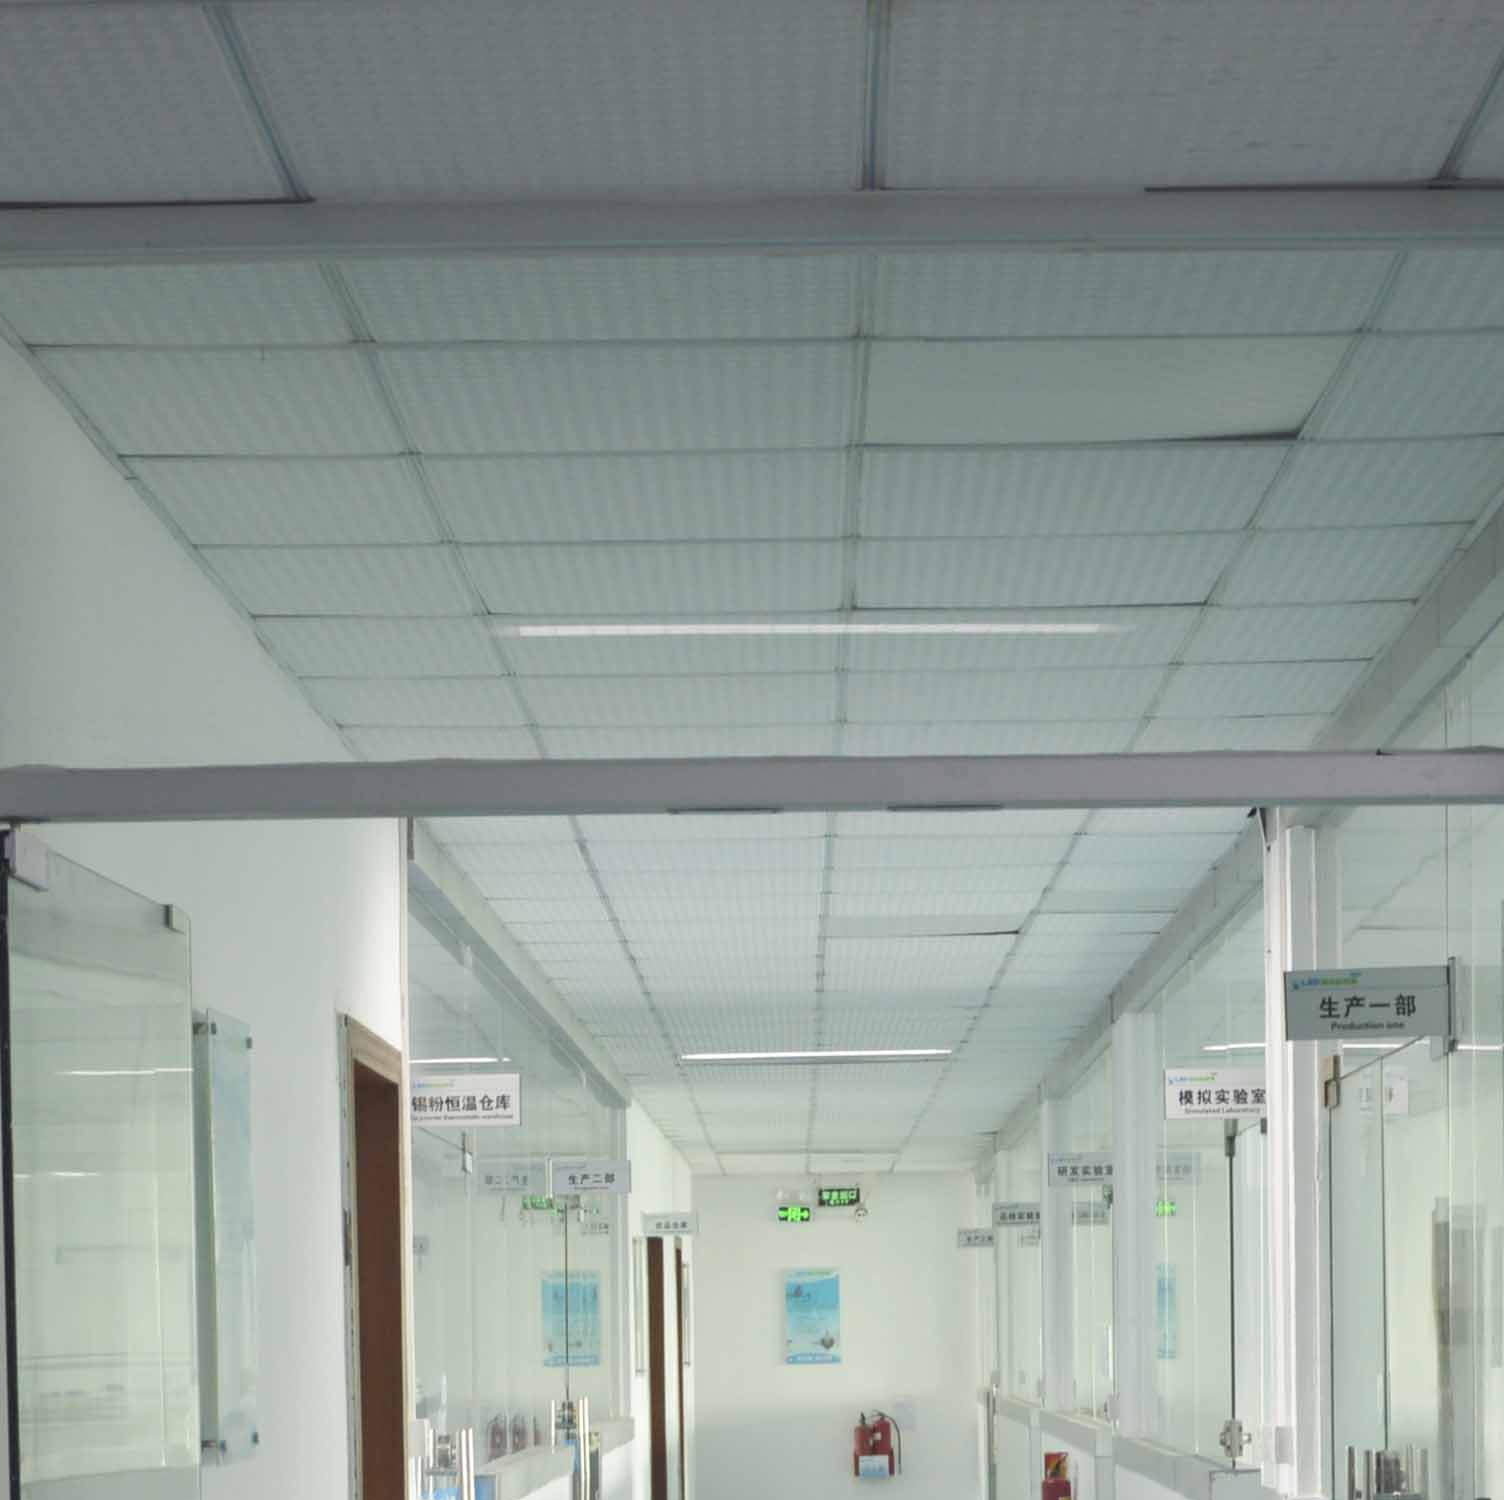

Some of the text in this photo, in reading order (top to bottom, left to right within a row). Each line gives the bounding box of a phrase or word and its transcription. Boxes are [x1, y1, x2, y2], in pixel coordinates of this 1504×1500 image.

[1320, 994, 1416, 1018] 生产一部
[1179, 1088, 1266, 1105] 模拟实验室
[568, 1173, 616, 1186] 生产二部
